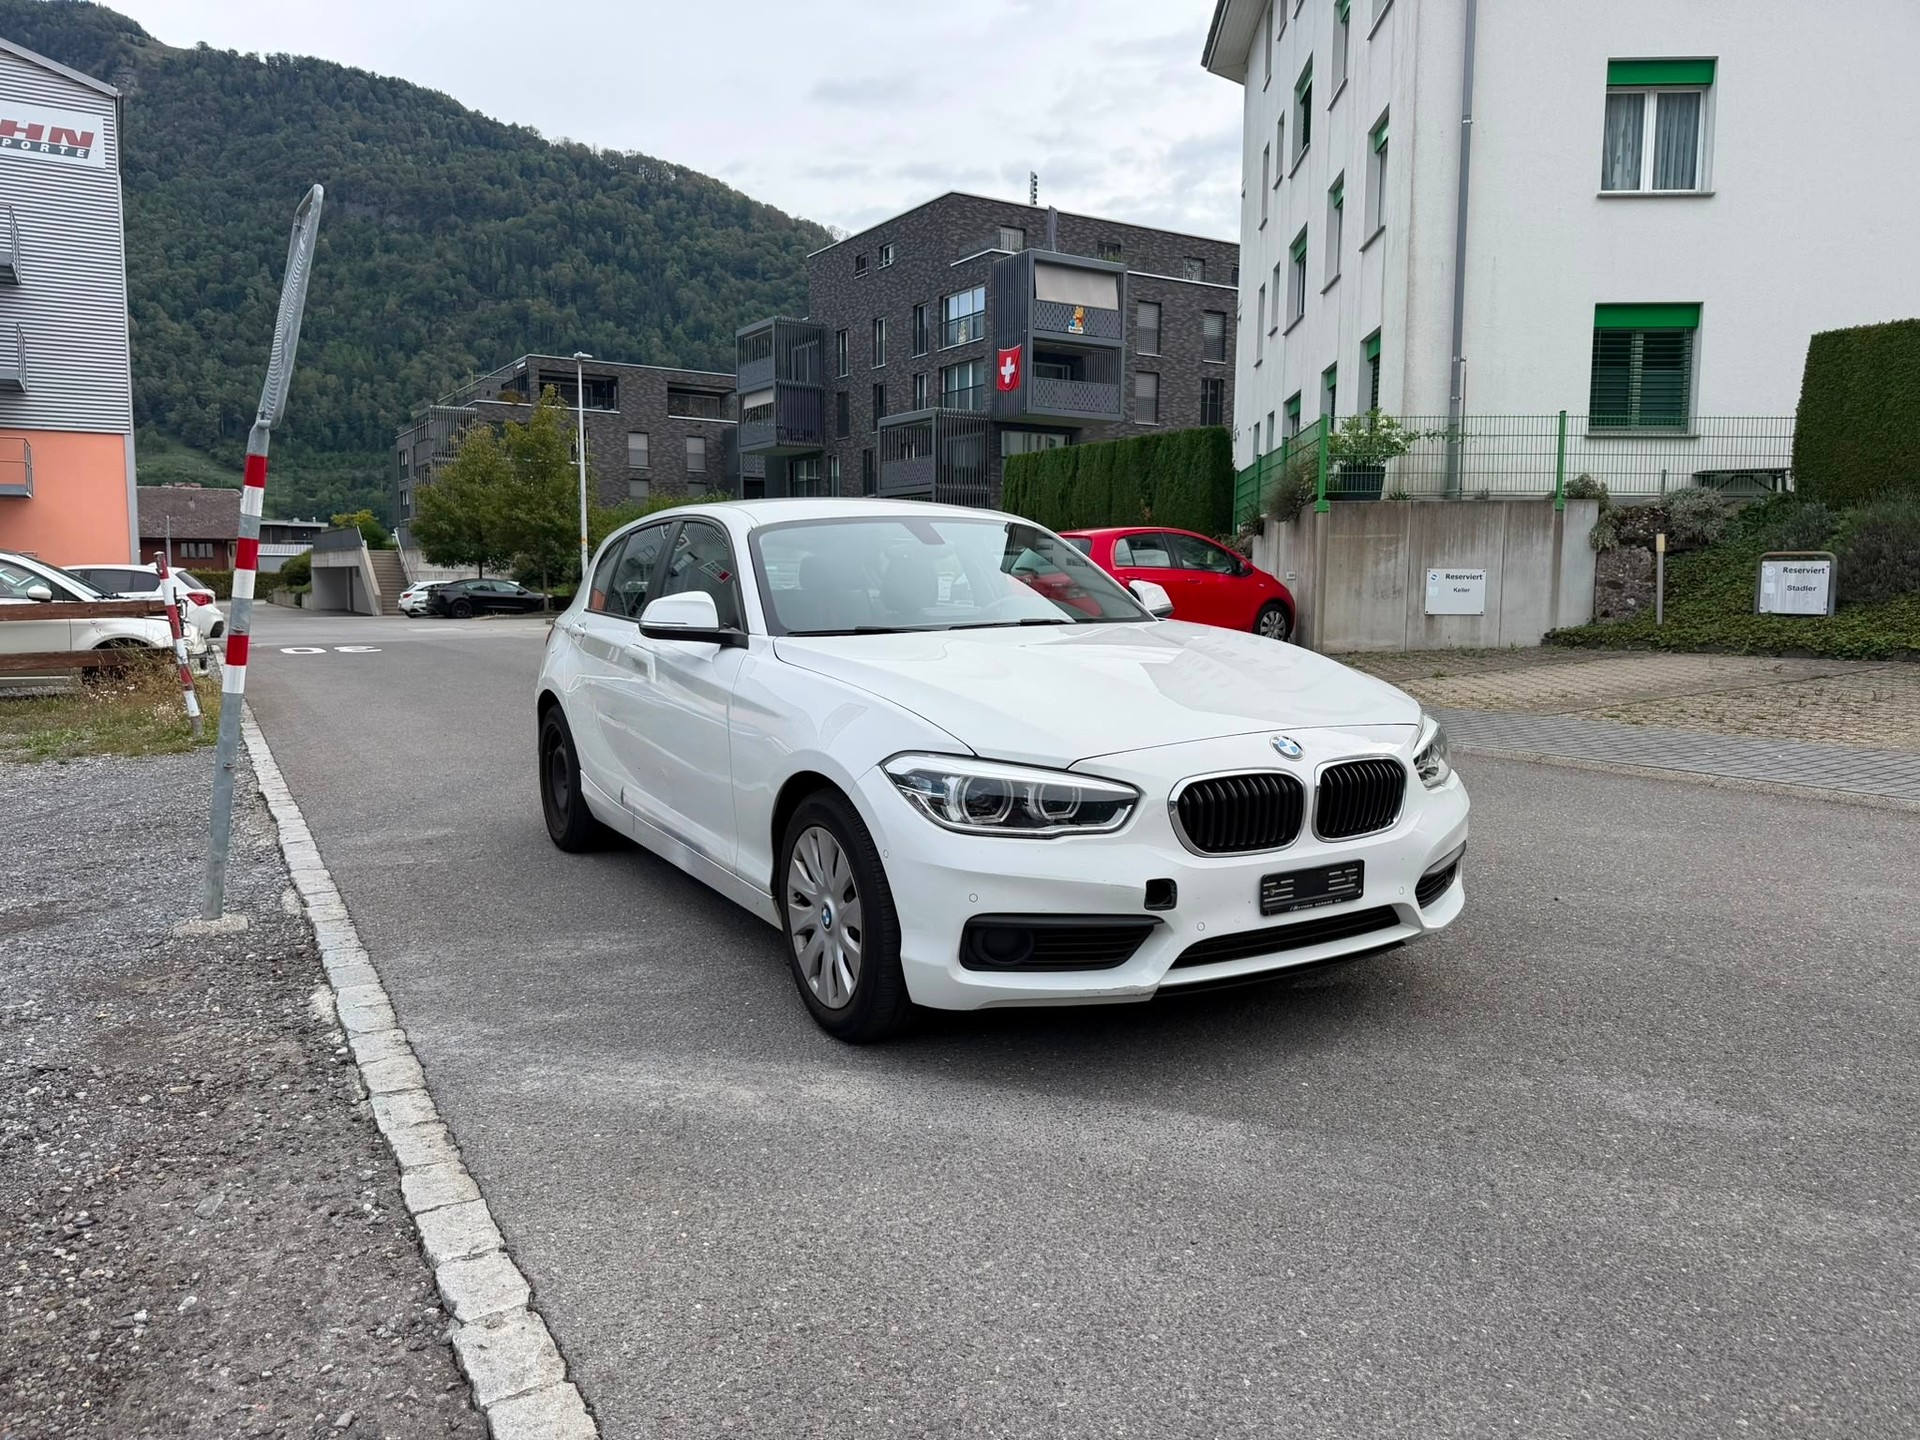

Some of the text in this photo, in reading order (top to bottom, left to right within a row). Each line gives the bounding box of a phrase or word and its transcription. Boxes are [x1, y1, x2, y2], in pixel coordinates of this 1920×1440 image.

[1, 138, 87, 158] PORTE
[1783, 566, 1826, 575] Reserviert
[1445, 573, 1483, 581] Reserviert
[1786, 584, 1817, 592] Stadler
